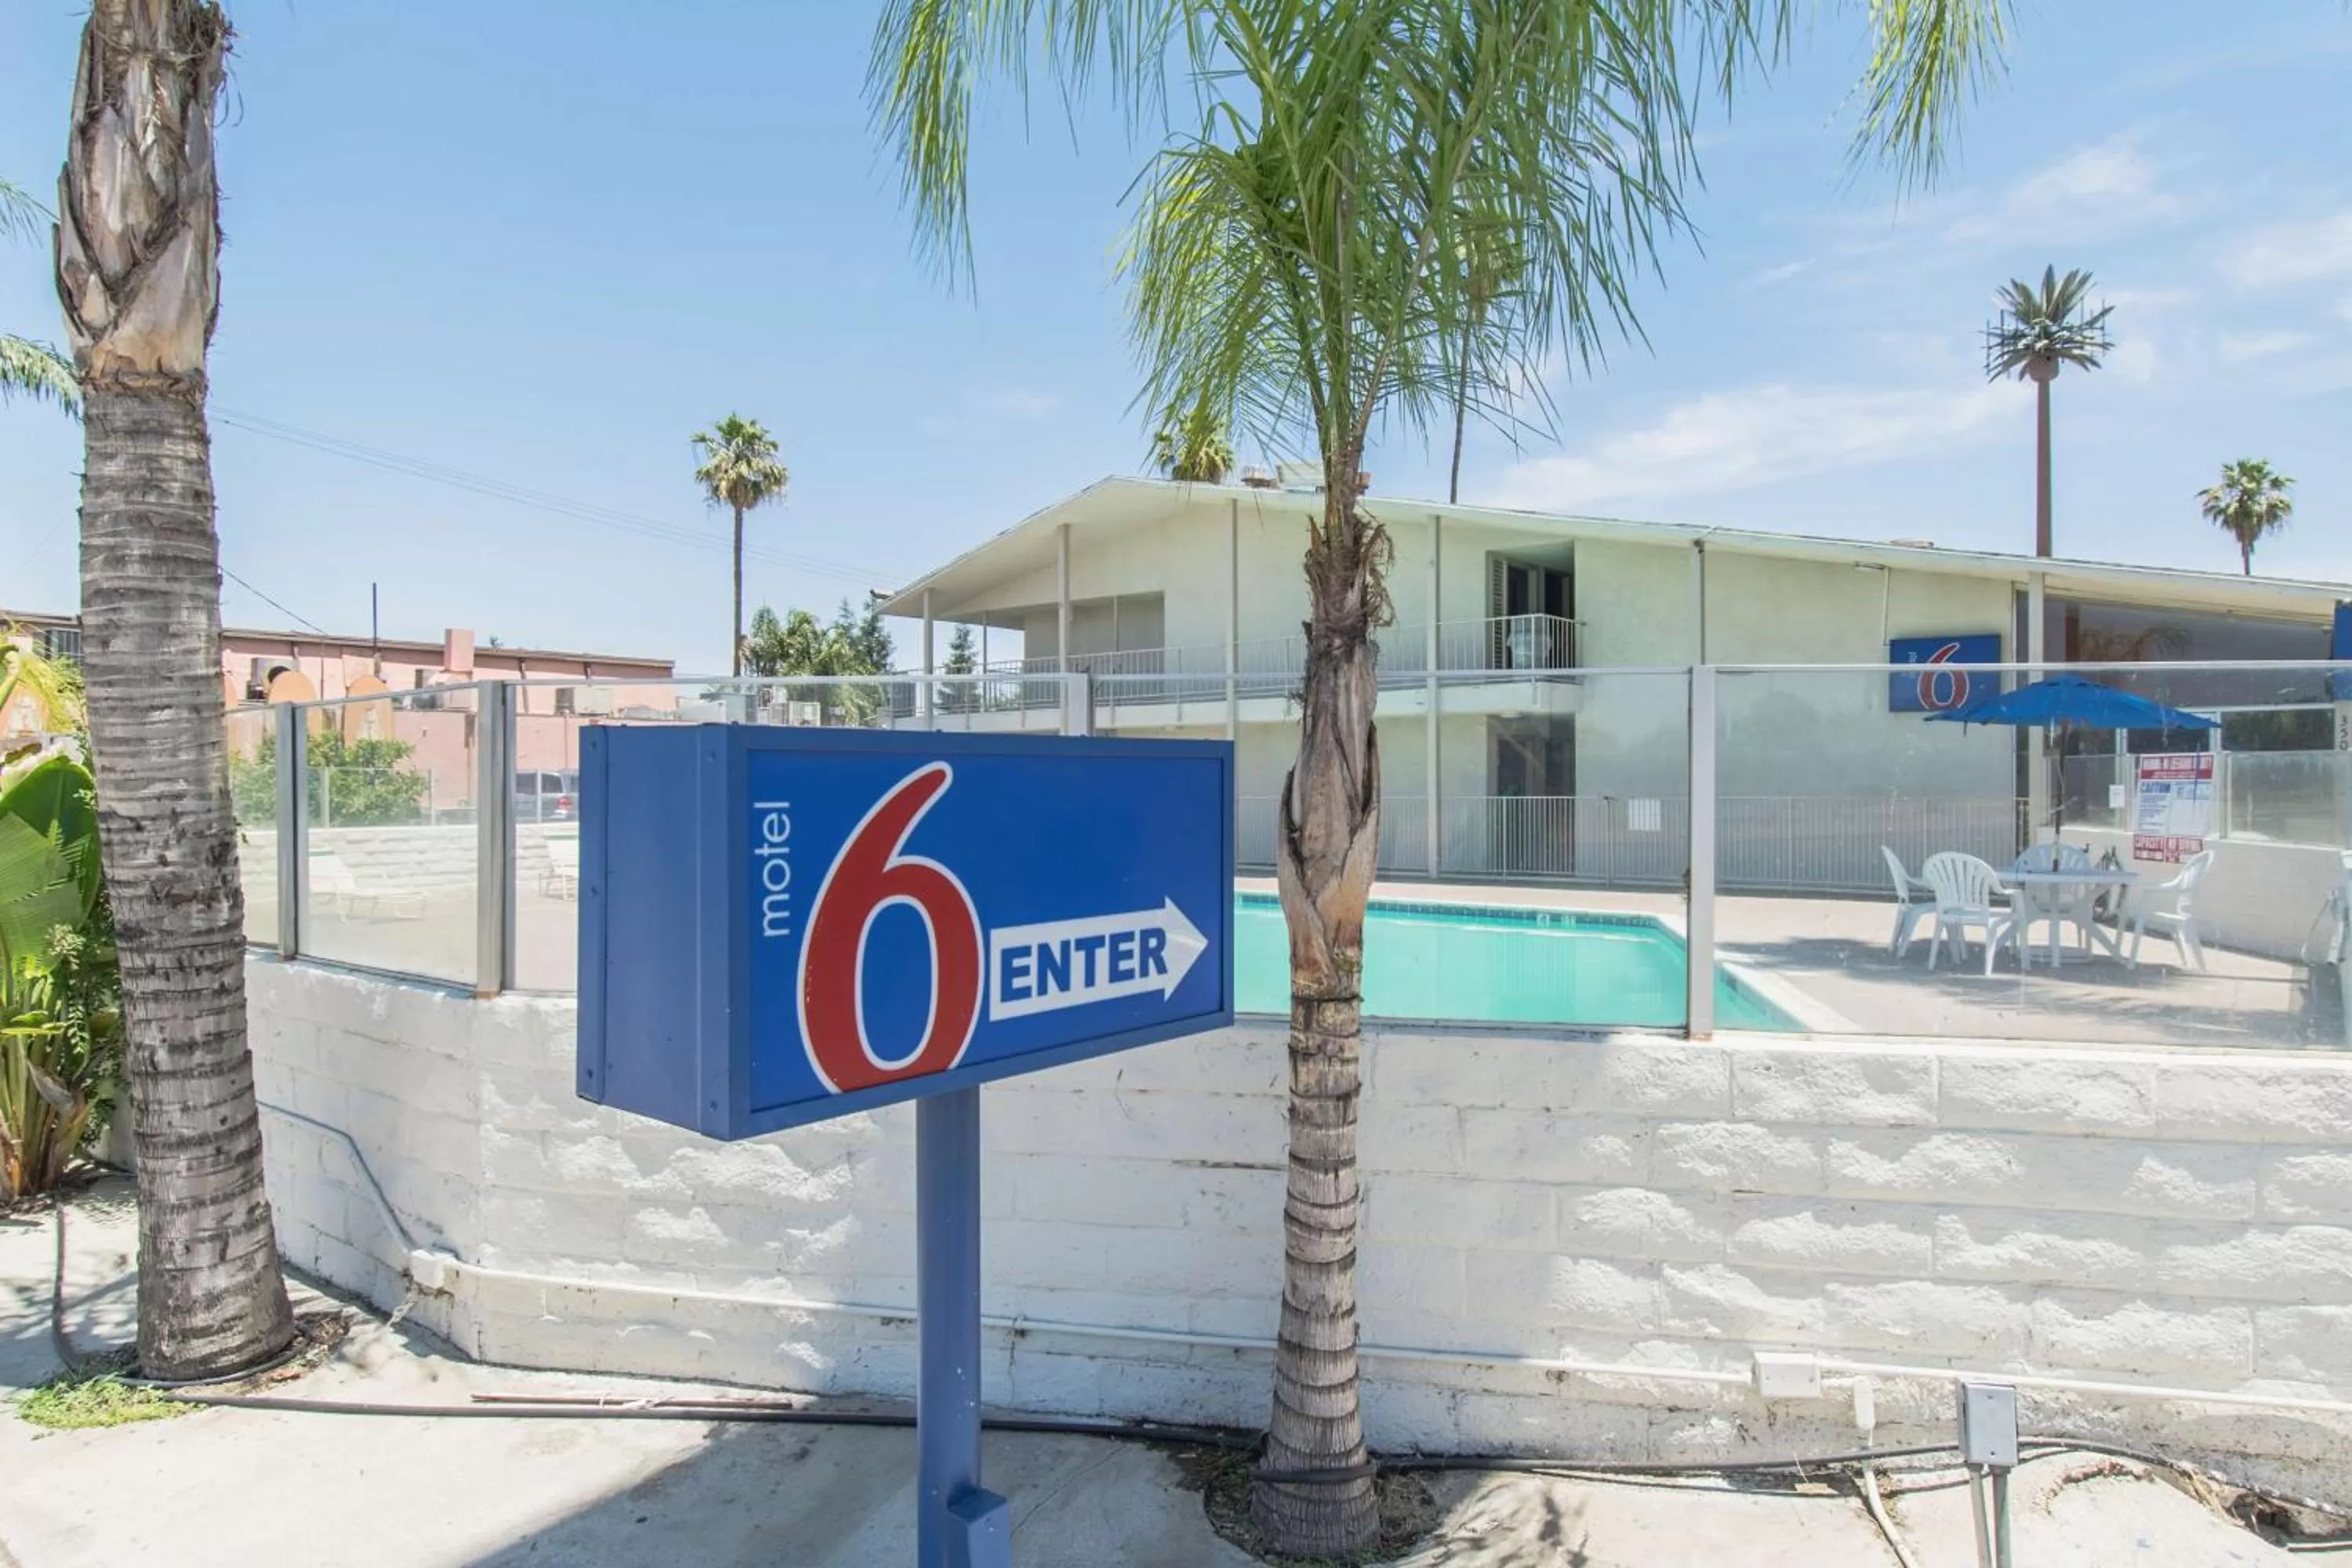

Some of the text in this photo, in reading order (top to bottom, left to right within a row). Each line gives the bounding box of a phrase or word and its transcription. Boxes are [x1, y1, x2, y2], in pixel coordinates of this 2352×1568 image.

[1918, 642, 1970, 709] 6
[753, 760, 985, 1094] motel 6
[1000, 927, 1167, 1003] ENTER
